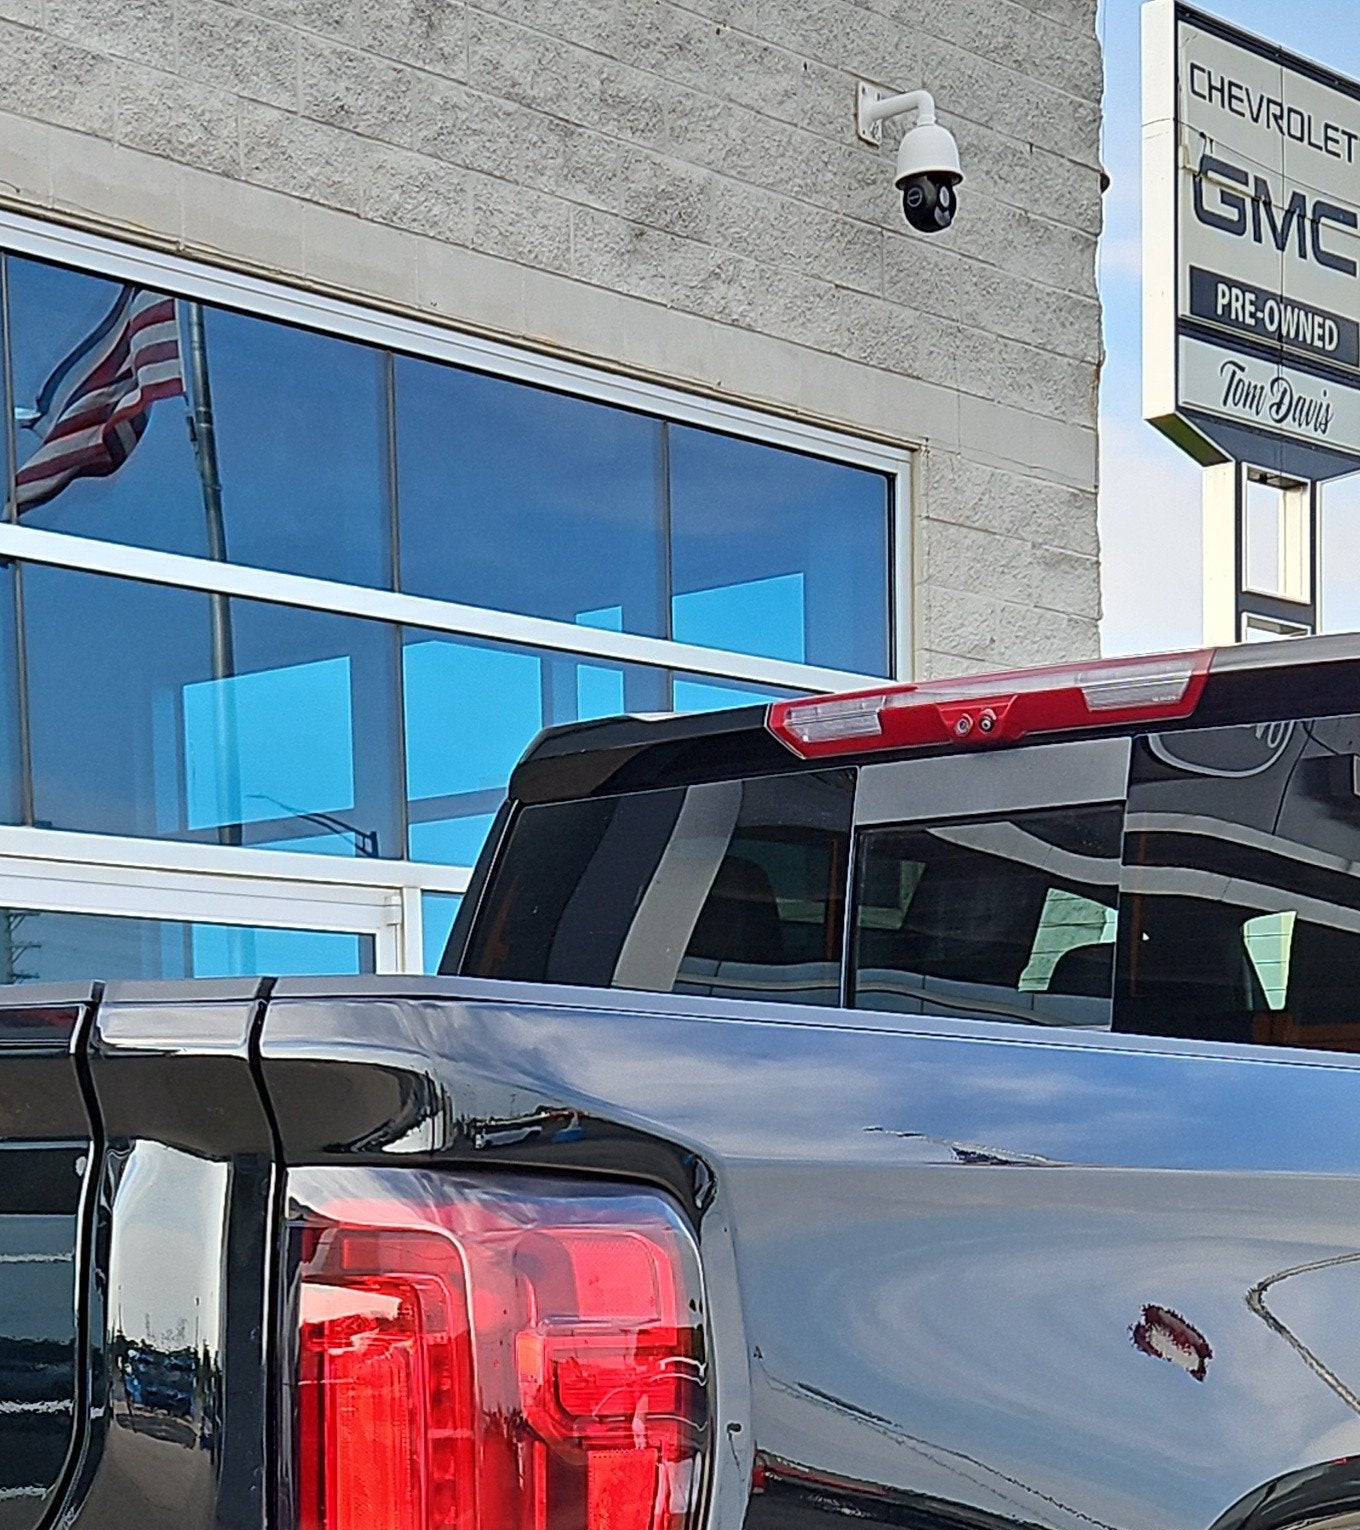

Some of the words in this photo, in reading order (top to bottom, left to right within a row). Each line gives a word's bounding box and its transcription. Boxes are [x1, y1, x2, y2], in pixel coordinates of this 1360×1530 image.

[1190, 61, 1359, 164] CHEVROLET
[1192, 153, 1358, 278] GMC
[1216, 282, 1339, 352] PRE-OWNED
[1219, 359, 1266, 417] Tom
[1269, 376, 1334, 435] Davis
